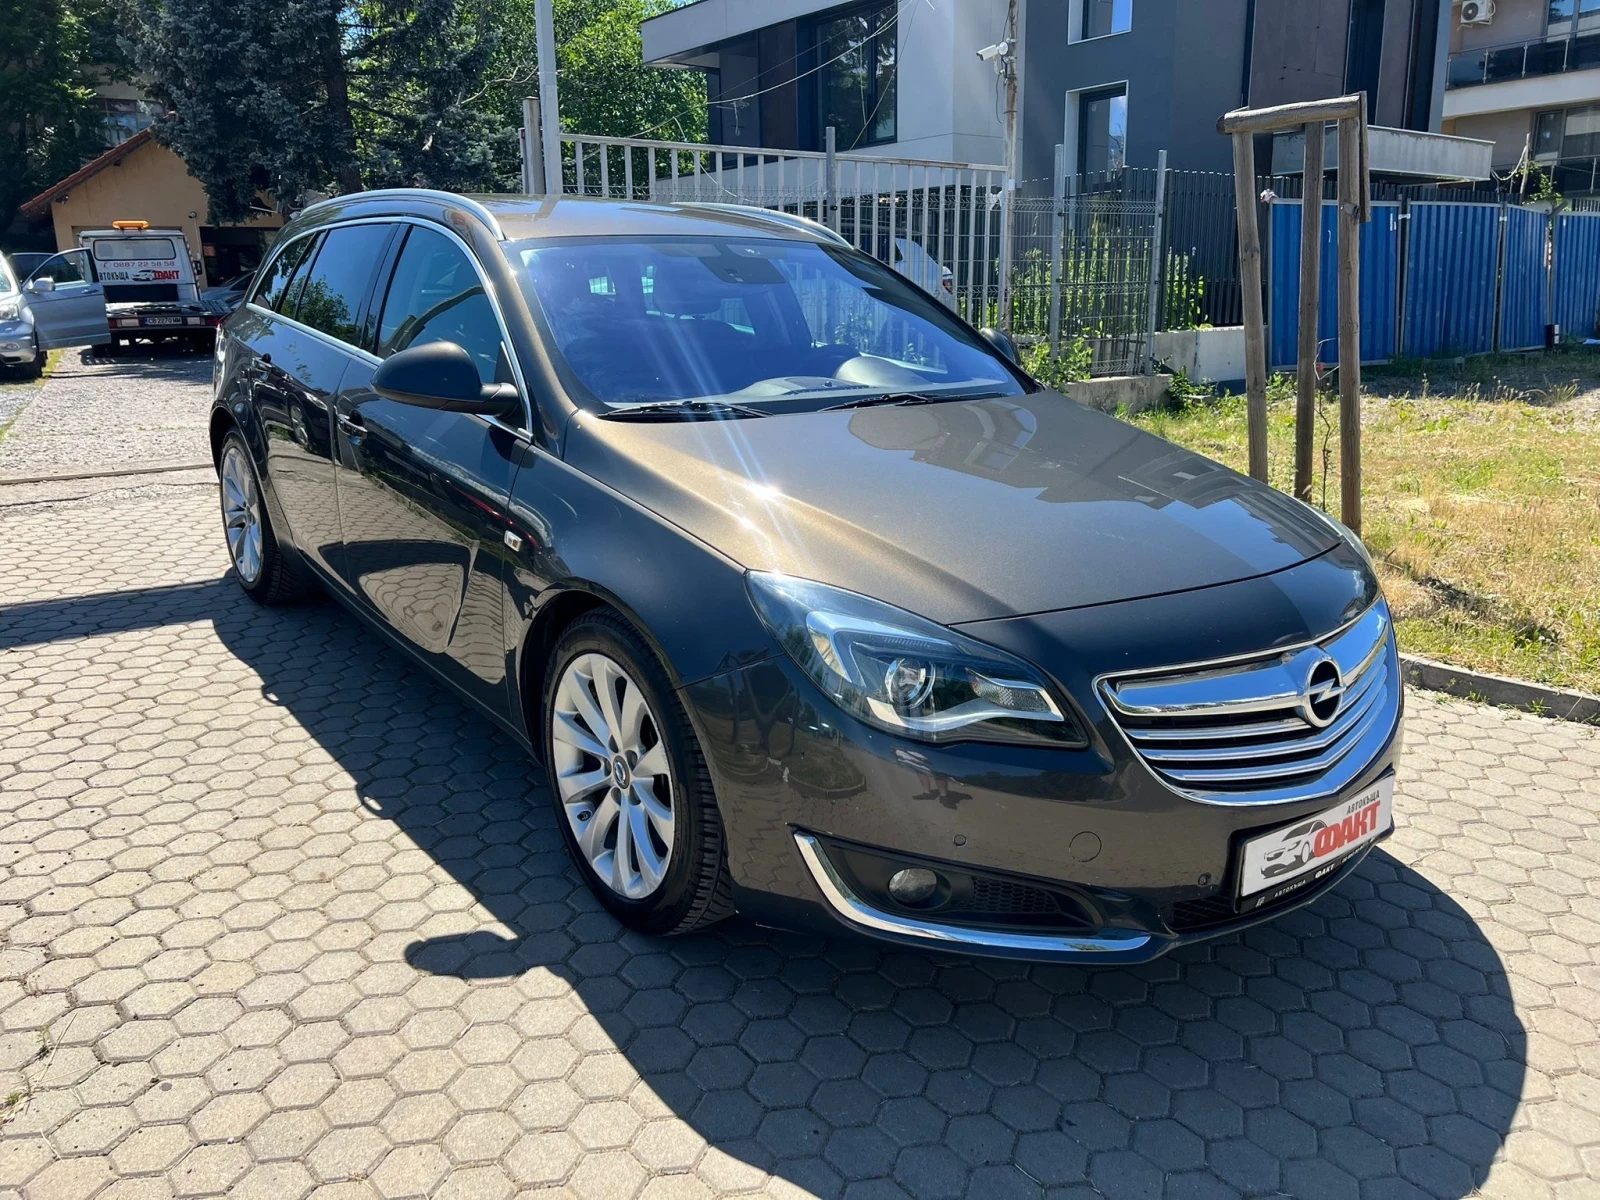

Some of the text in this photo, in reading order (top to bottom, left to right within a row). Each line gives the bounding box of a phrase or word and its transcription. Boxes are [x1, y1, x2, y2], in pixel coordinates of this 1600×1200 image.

[99, 270, 180, 281] ВТОКЪЩА ФАКТ
[1346, 789, 1380, 815] АВТОКЪЩА
[1313, 800, 1381, 858] ФАКТ
[1273, 863, 1335, 898] АВТОКЪЩА ФАКТ
